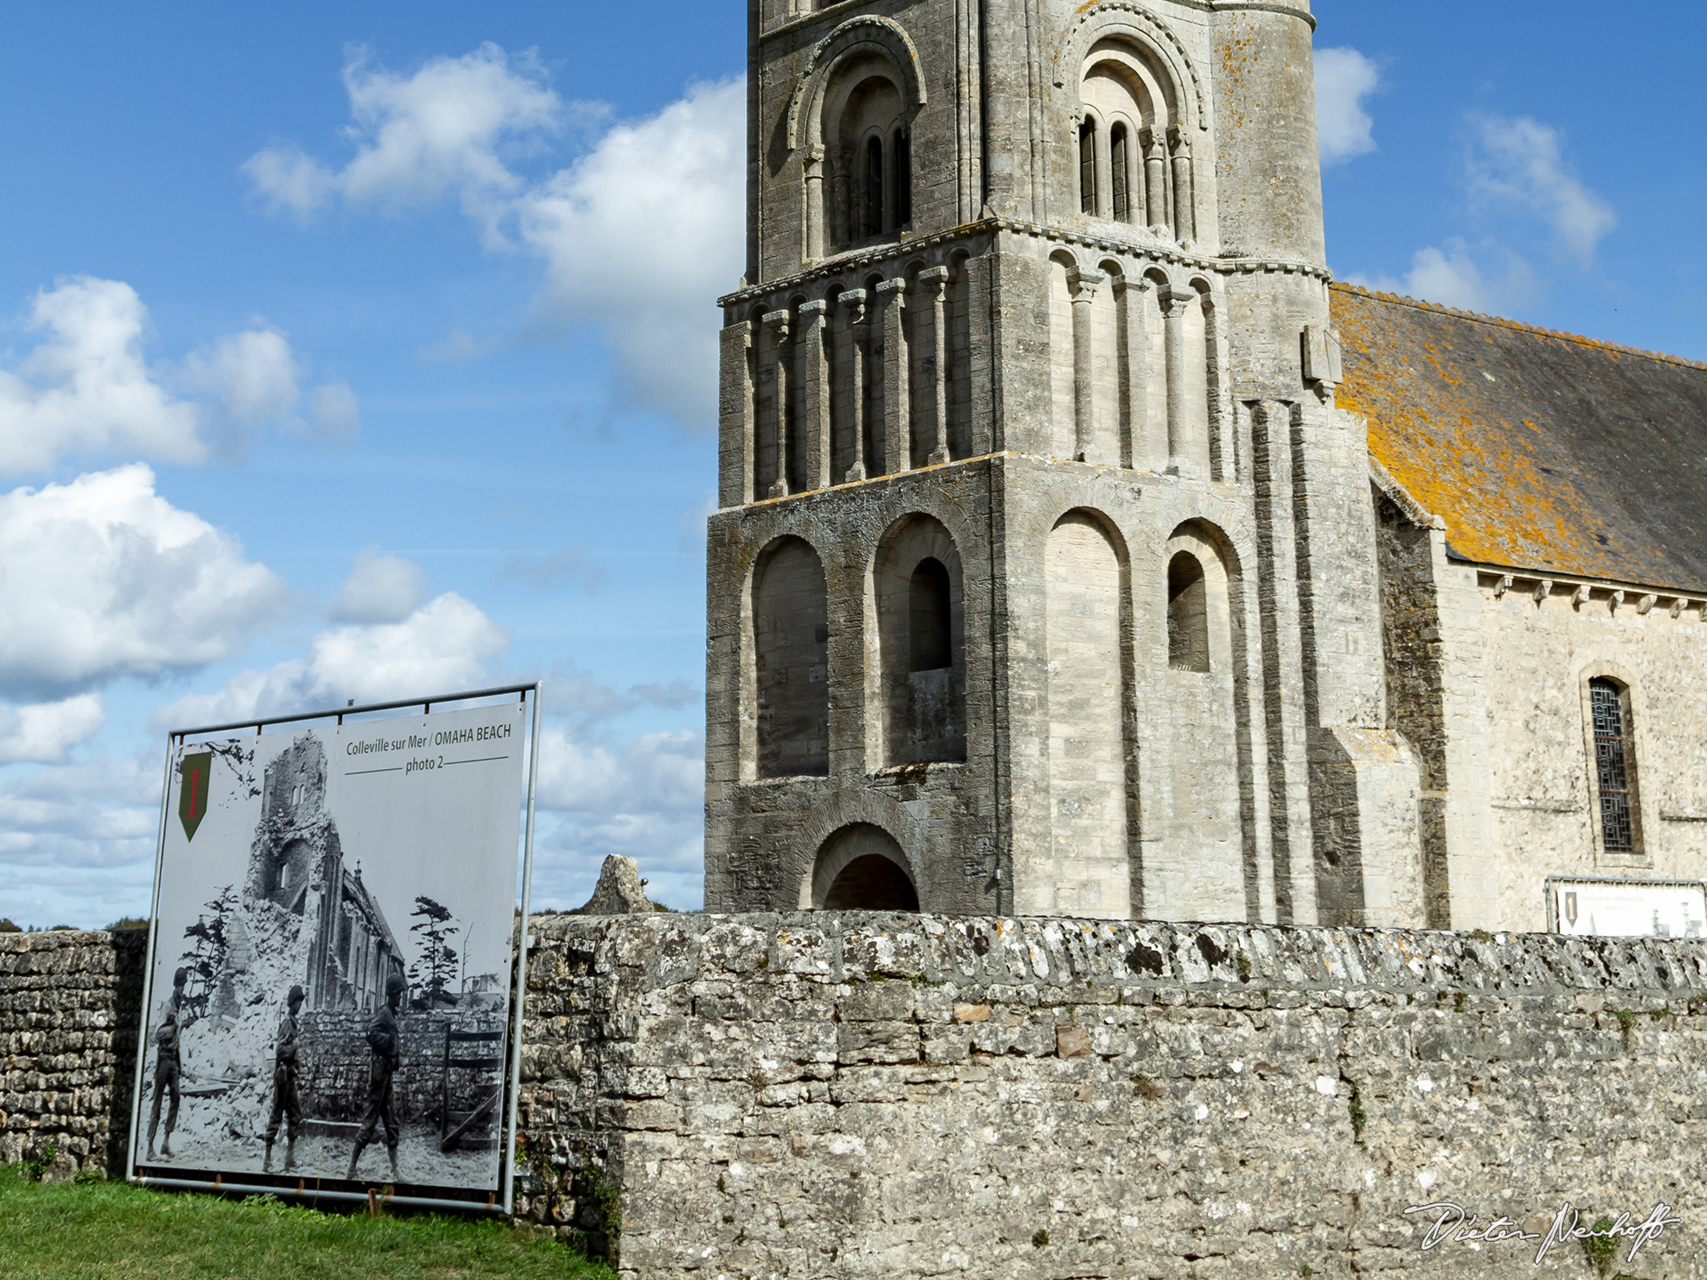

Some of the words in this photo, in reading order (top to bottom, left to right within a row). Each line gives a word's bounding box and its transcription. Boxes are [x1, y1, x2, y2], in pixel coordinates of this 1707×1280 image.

[346, 738, 389, 755] Colleville
[391, 739, 405, 751] sur
[408, 734, 427, 749] Mer
[434, 728, 474, 746] OMAHA
[477, 723, 511, 741] BEACH
[405, 757, 435, 775] photo
[437, 755, 444, 769] 2
[187, 768, 200, 818] 1
[1567, 897, 1575, 920] 1
